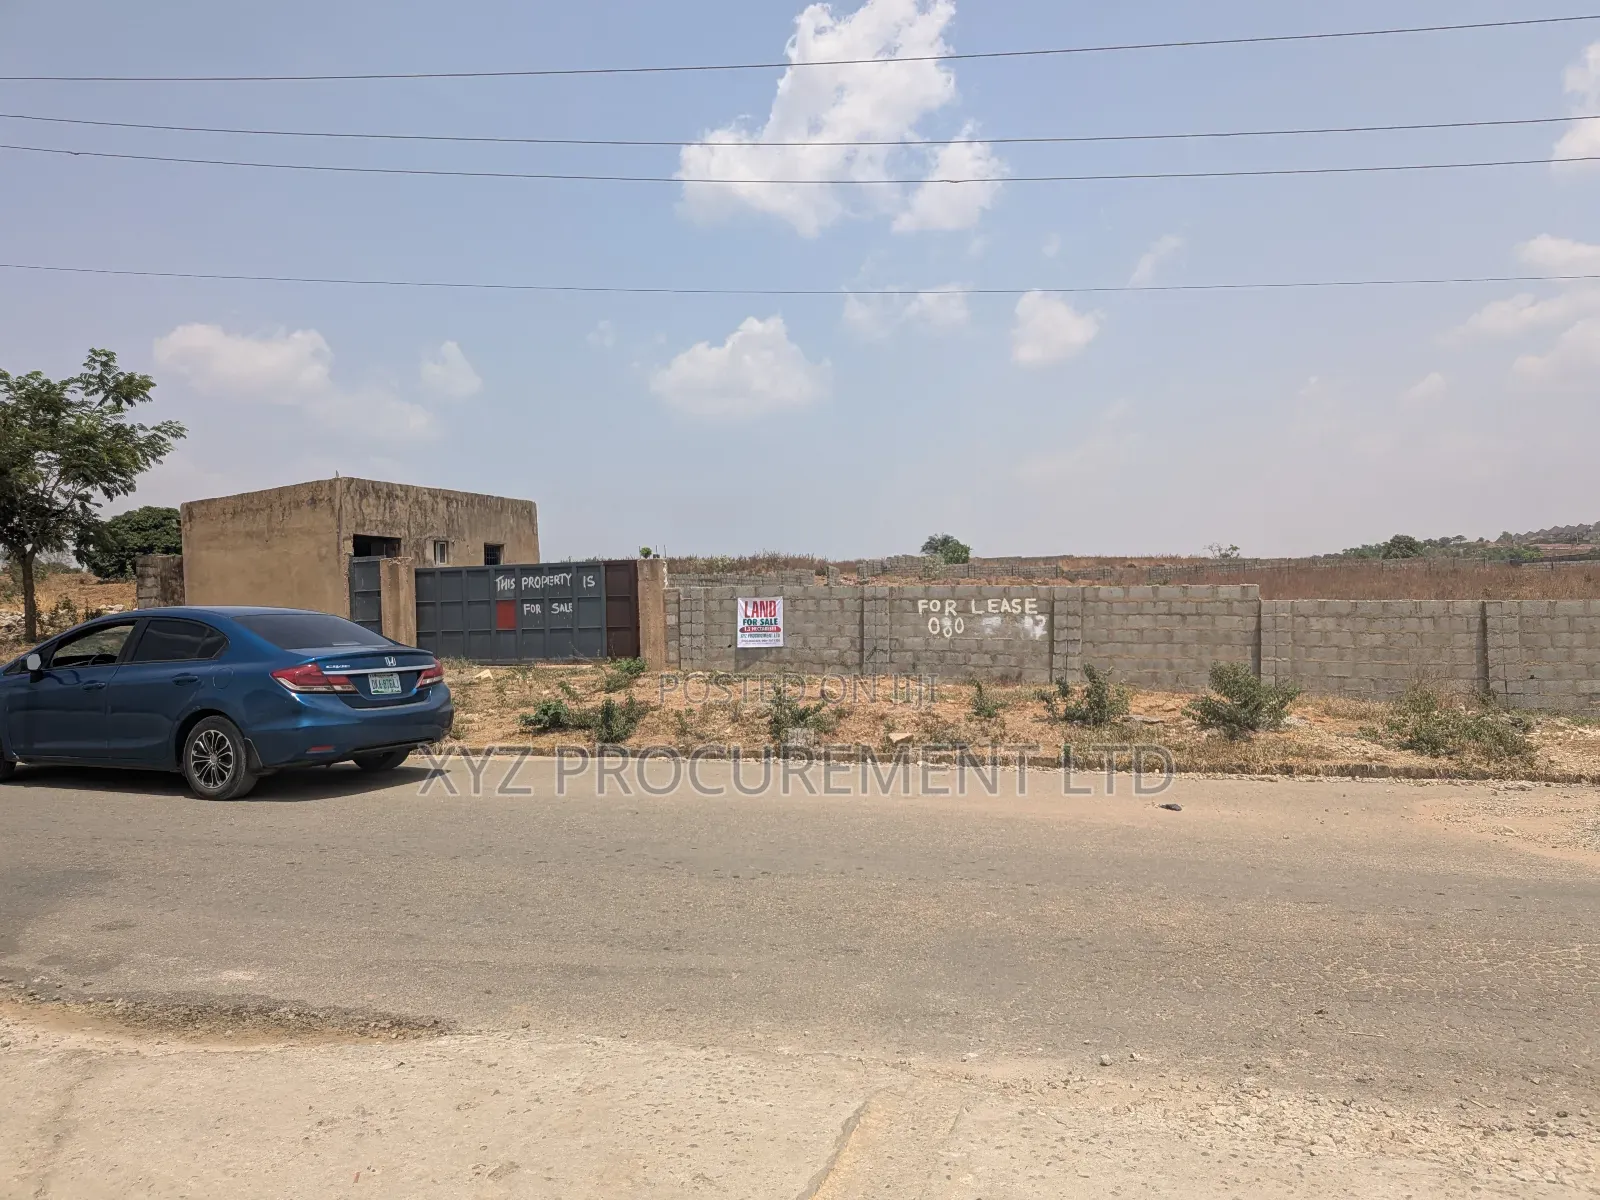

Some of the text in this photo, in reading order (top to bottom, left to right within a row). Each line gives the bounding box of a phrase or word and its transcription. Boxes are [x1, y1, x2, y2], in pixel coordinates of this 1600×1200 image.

[495, 573, 595, 592] THIS PROPERTY IS
[523, 602, 573, 615] FOR SALE
[744, 600, 776, 618] LAND
[917, 597, 1038, 617] FOR LEASE
